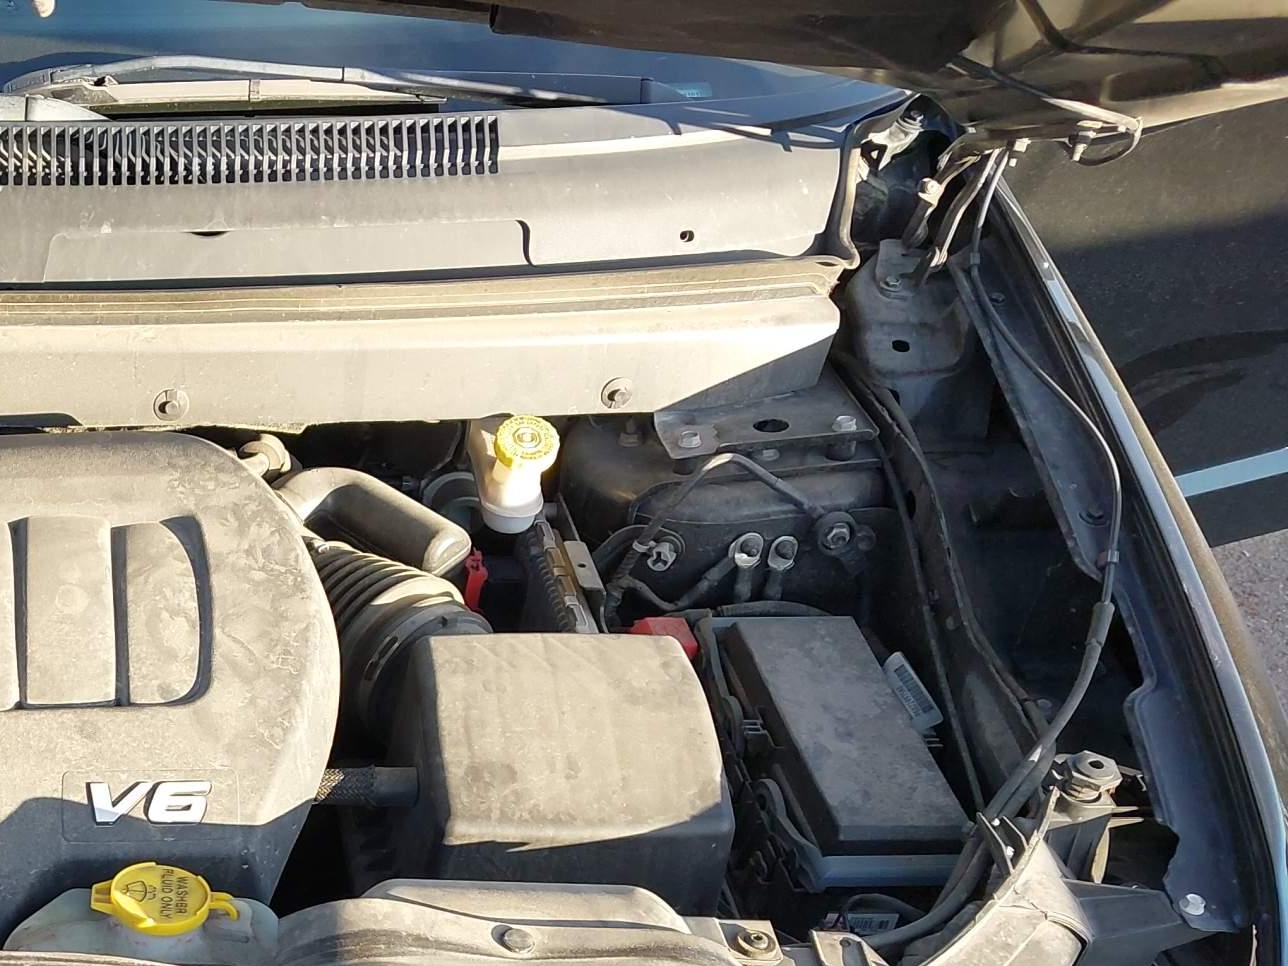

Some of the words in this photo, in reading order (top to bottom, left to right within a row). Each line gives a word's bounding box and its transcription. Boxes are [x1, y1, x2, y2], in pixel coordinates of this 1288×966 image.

[86, 780, 212, 825] V6
[161, 868, 174, 893] FLUID
[175, 876, 189, 914] WASHER
[159, 896, 173, 919] ONLY
